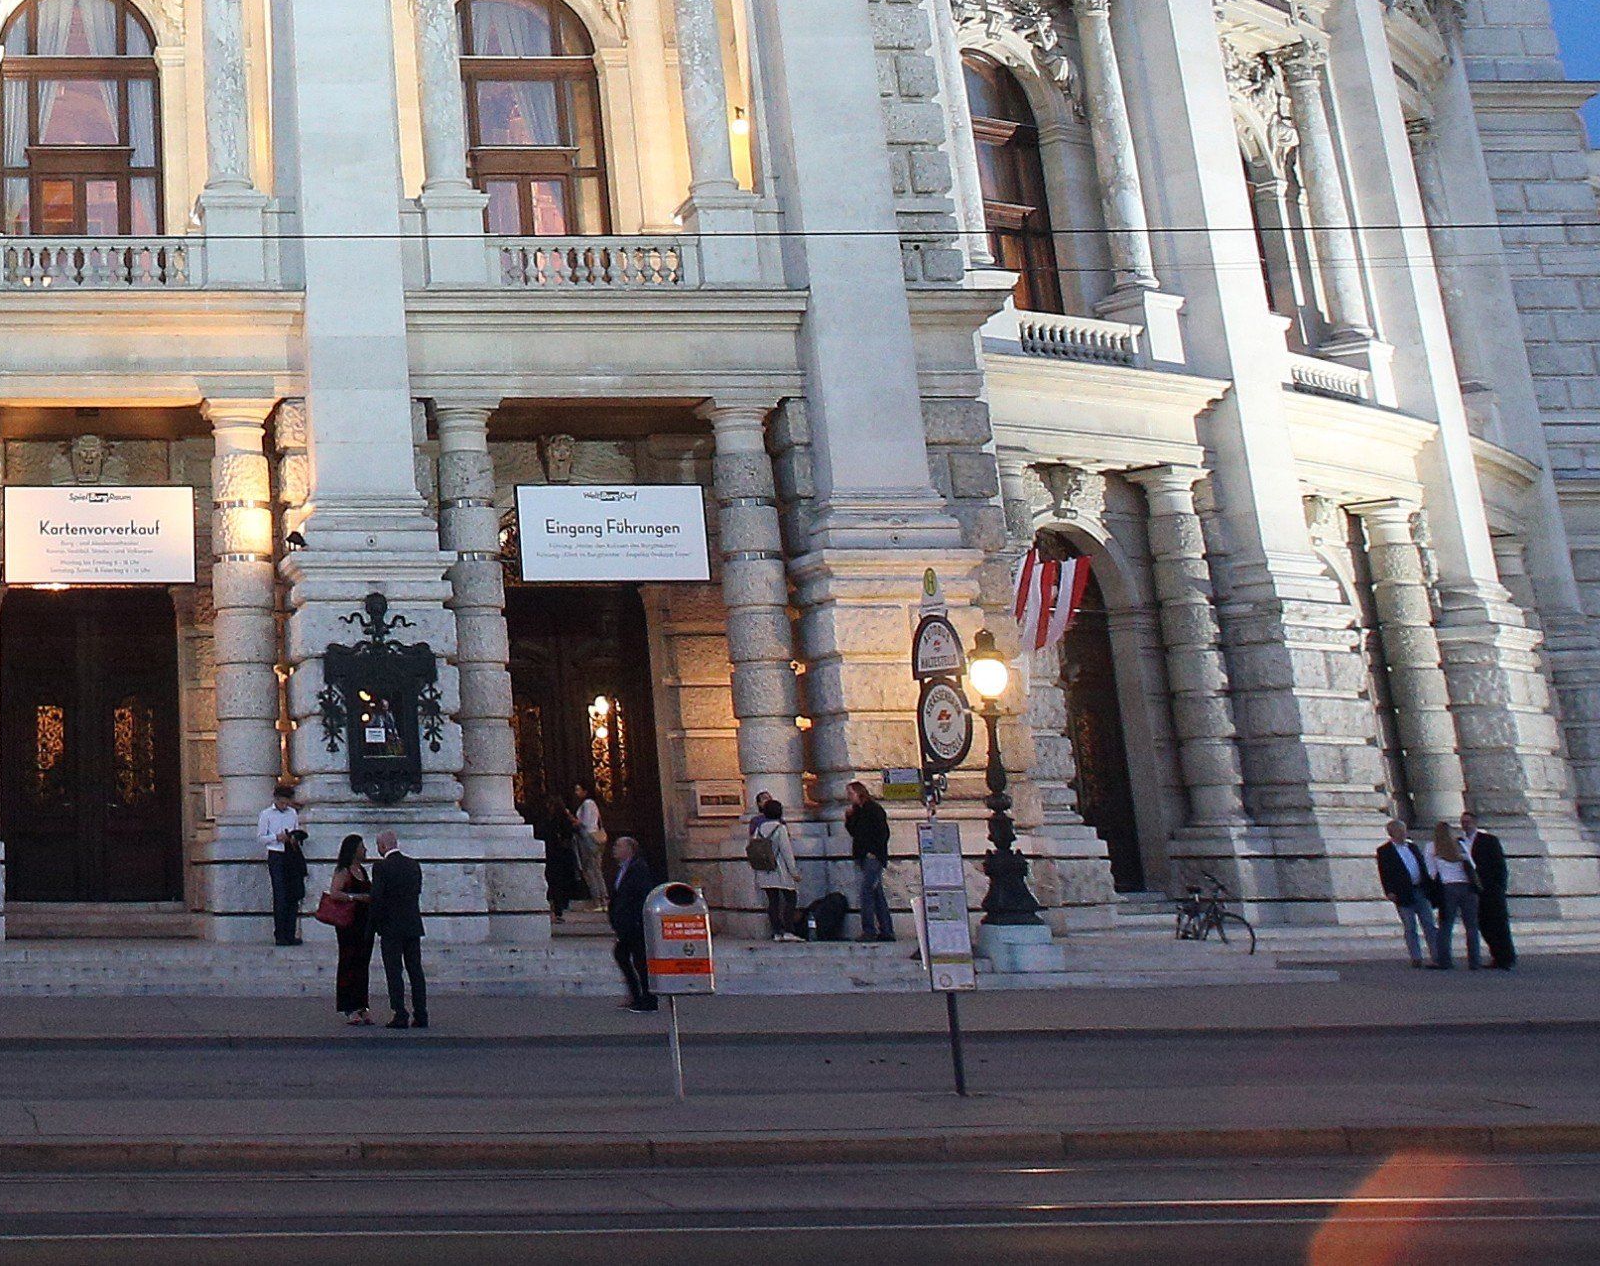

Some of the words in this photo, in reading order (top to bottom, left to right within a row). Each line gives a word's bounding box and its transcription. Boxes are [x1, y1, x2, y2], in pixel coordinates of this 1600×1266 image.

[39, 519, 161, 536] Kartenvorverkauf
[545, 519, 603, 538] Eingang
[606, 518, 680, 538] Führungen
